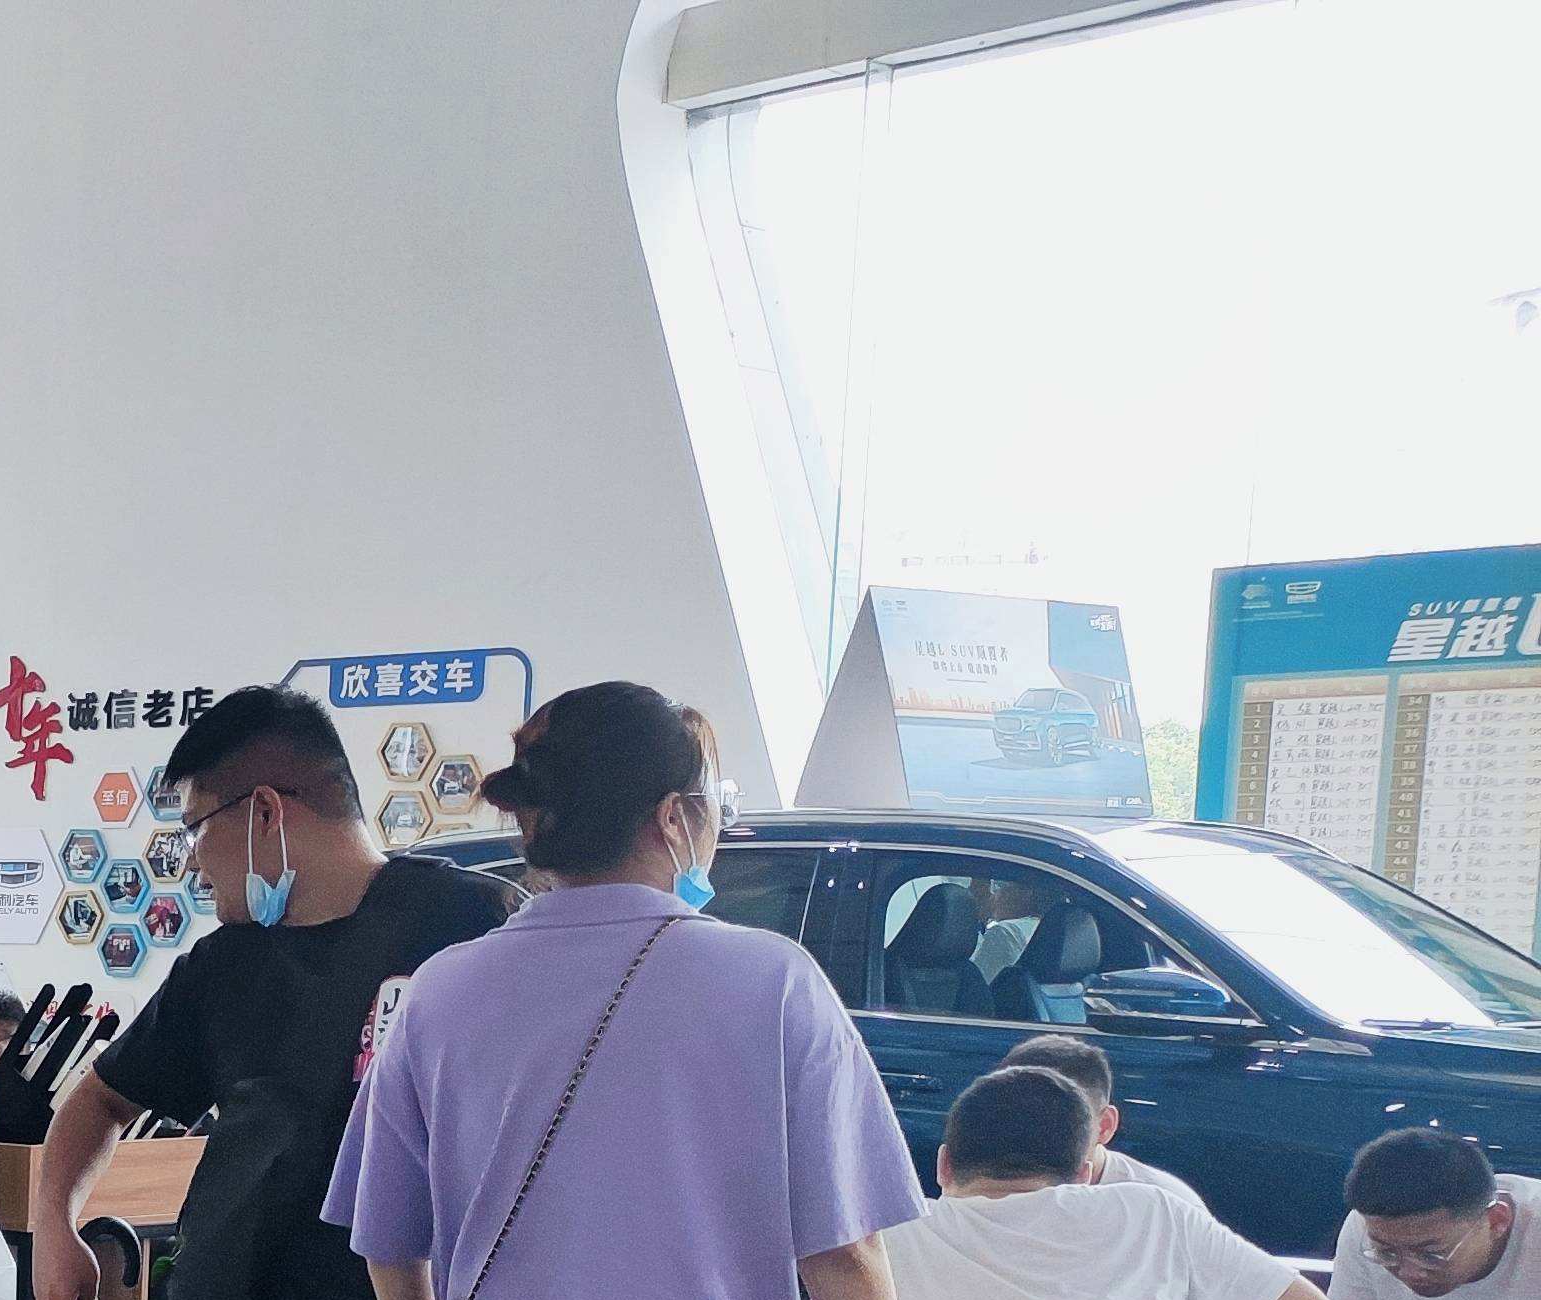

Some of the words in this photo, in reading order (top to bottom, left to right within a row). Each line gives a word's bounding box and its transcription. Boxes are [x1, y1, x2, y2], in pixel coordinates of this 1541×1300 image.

[339, 657, 474, 699] 欣喜交车
[67, 687, 215, 731] 诚信老店
[100, 790, 129, 807] 至信
[15, 907, 39, 915] AUTO
